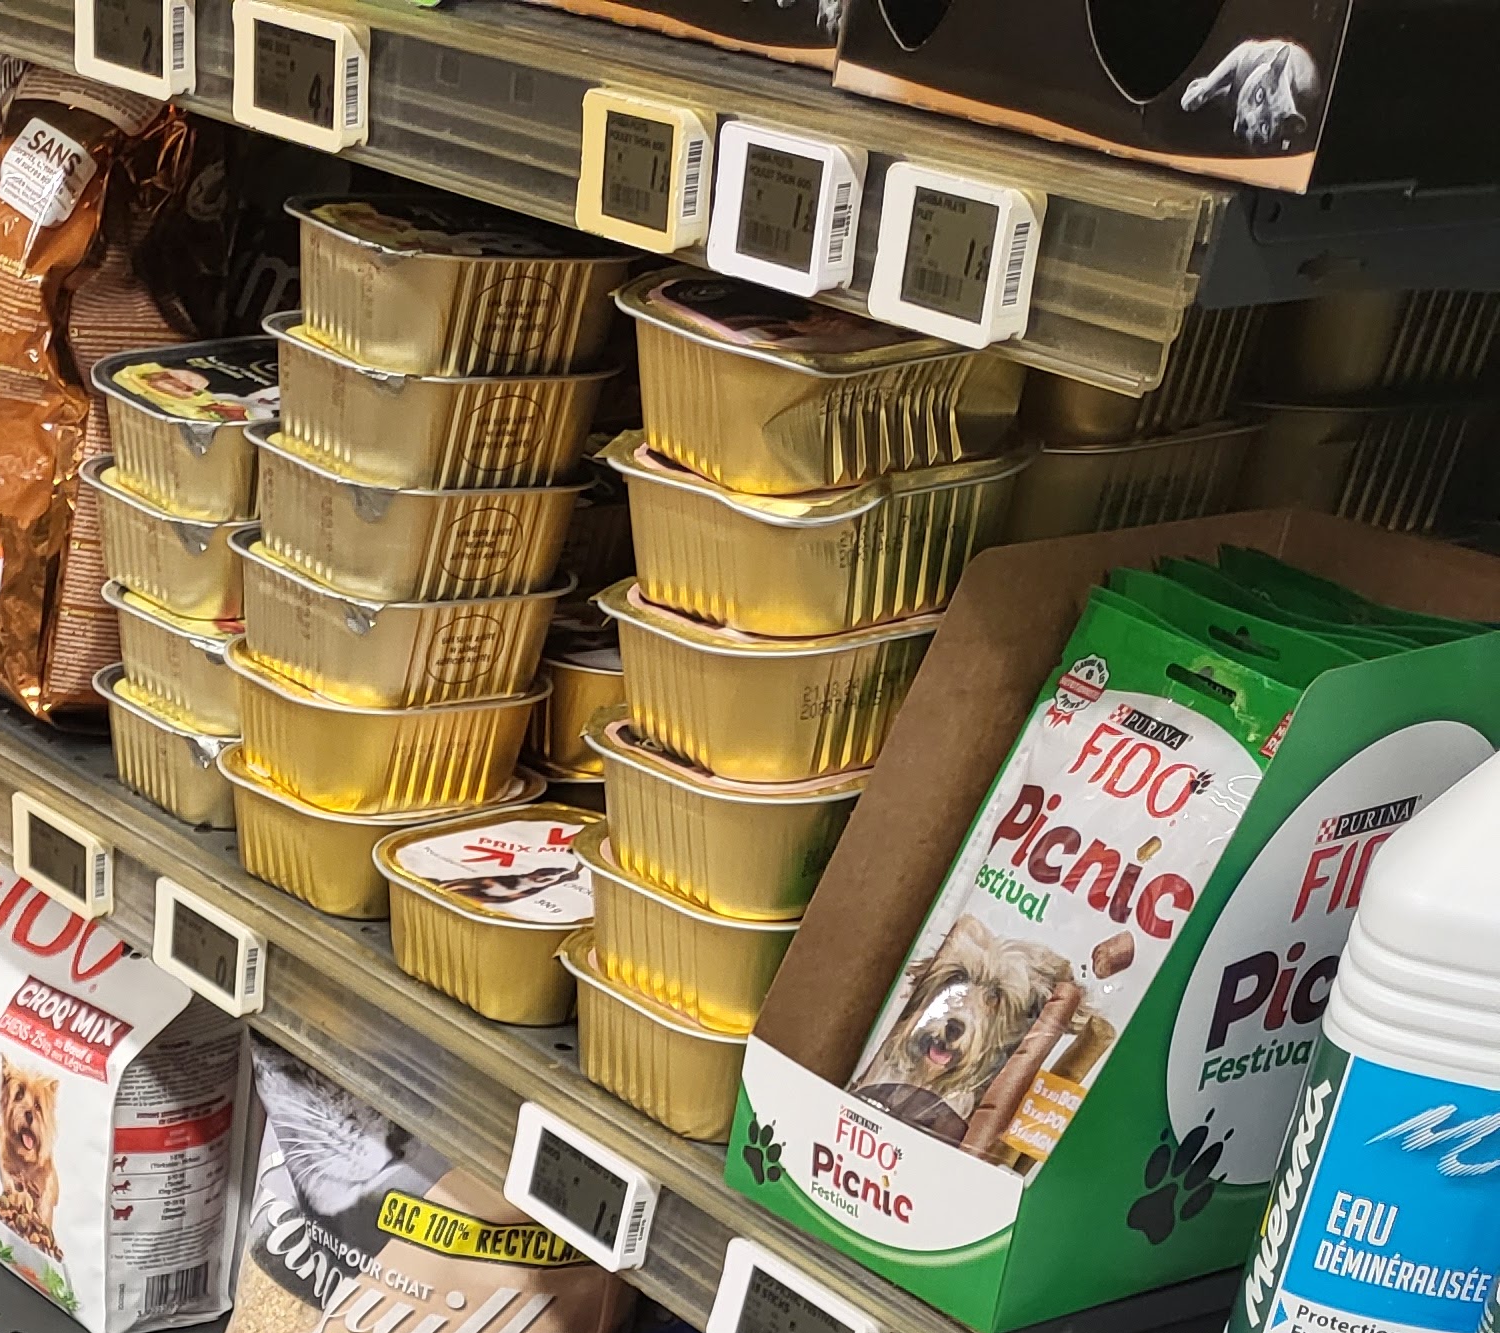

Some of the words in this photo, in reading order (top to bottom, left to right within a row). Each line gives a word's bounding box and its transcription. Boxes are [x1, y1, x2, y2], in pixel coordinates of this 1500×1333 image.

[27, 129, 83, 178] SANS
[1124, 711, 1185, 751] PURINA
[1067, 722, 1198, 820] FIDO
[1334, 798, 1416, 839] PURINA
[987, 783, 1196, 940] Picnic
[974, 862, 1052, 924] estival
[15, 982, 121, 1048] CROQ'MIX
[1204, 942, 1341, 1053] Pic
[1197, 1040, 1311, 1092] Festiva
[835, 1117, 899, 1171] FIDO
[810, 1181, 860, 1220] Festival
[811, 1142, 914, 1225] Picnic
[381, 1196, 418, 1234] SAC
[425, 1212, 472, 1250] 100%
[1325, 1189, 1399, 1248] EAU
[337, 1240, 383, 1282] POUR
[384, 1265, 434, 1301] CHAT
[1312, 1237, 1494, 1304] DÉMINÉRALISÉE
